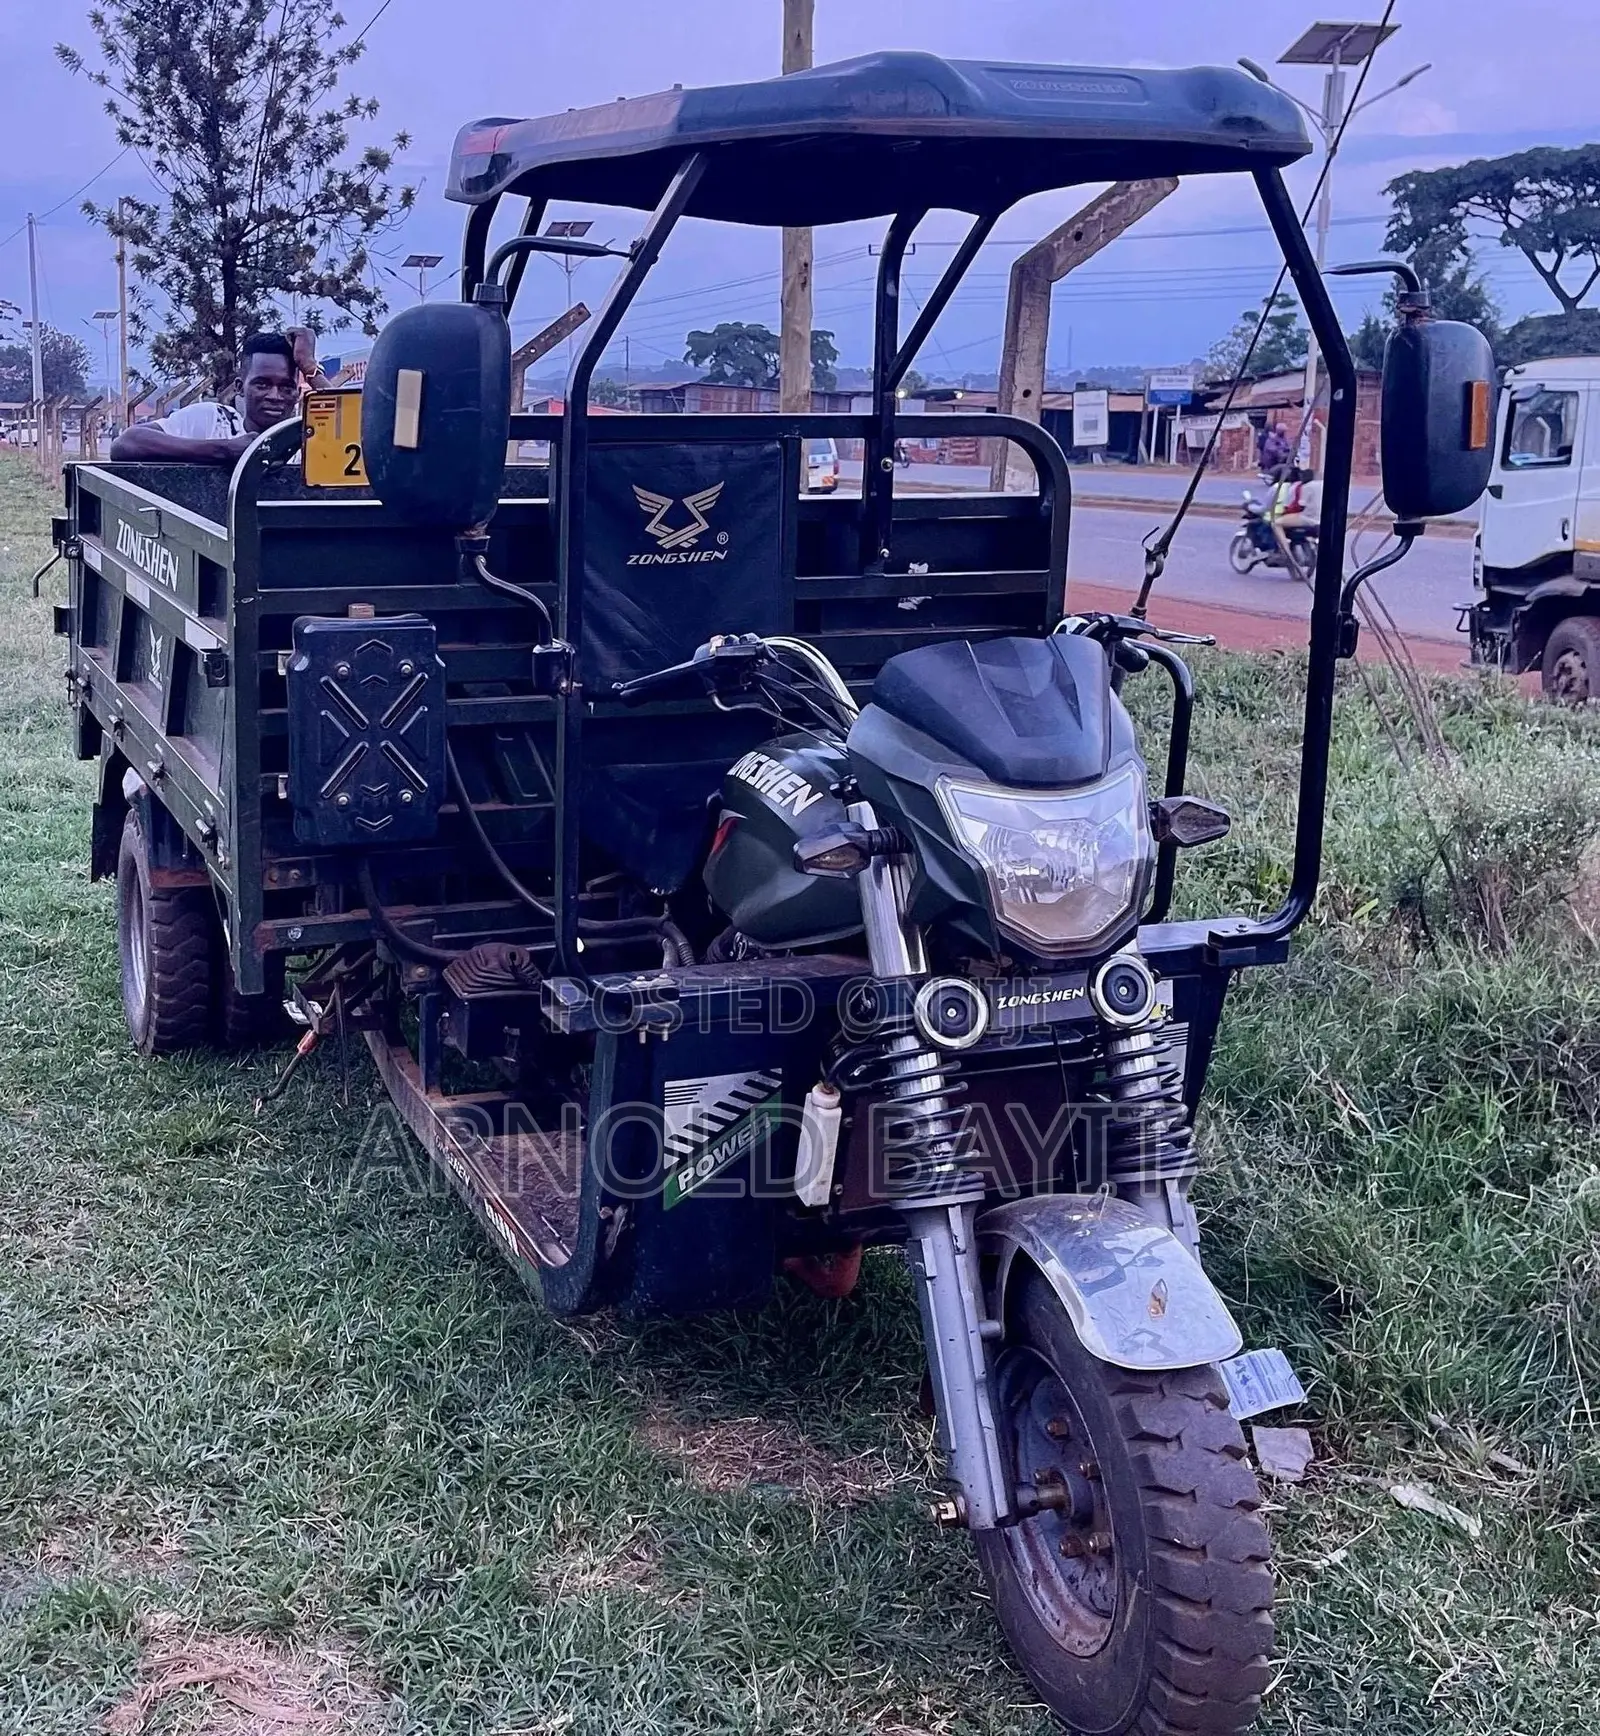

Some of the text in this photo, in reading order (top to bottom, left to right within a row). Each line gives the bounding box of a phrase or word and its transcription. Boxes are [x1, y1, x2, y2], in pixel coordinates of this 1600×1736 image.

[344, 443, 361, 476] 2
[115, 518, 179, 593] ZONGSHEN
[626, 549, 728, 565] ZONGSHEN
[996, 986, 1084, 1010] ZONGSHEN
[677, 1111, 771, 1192] POWER
